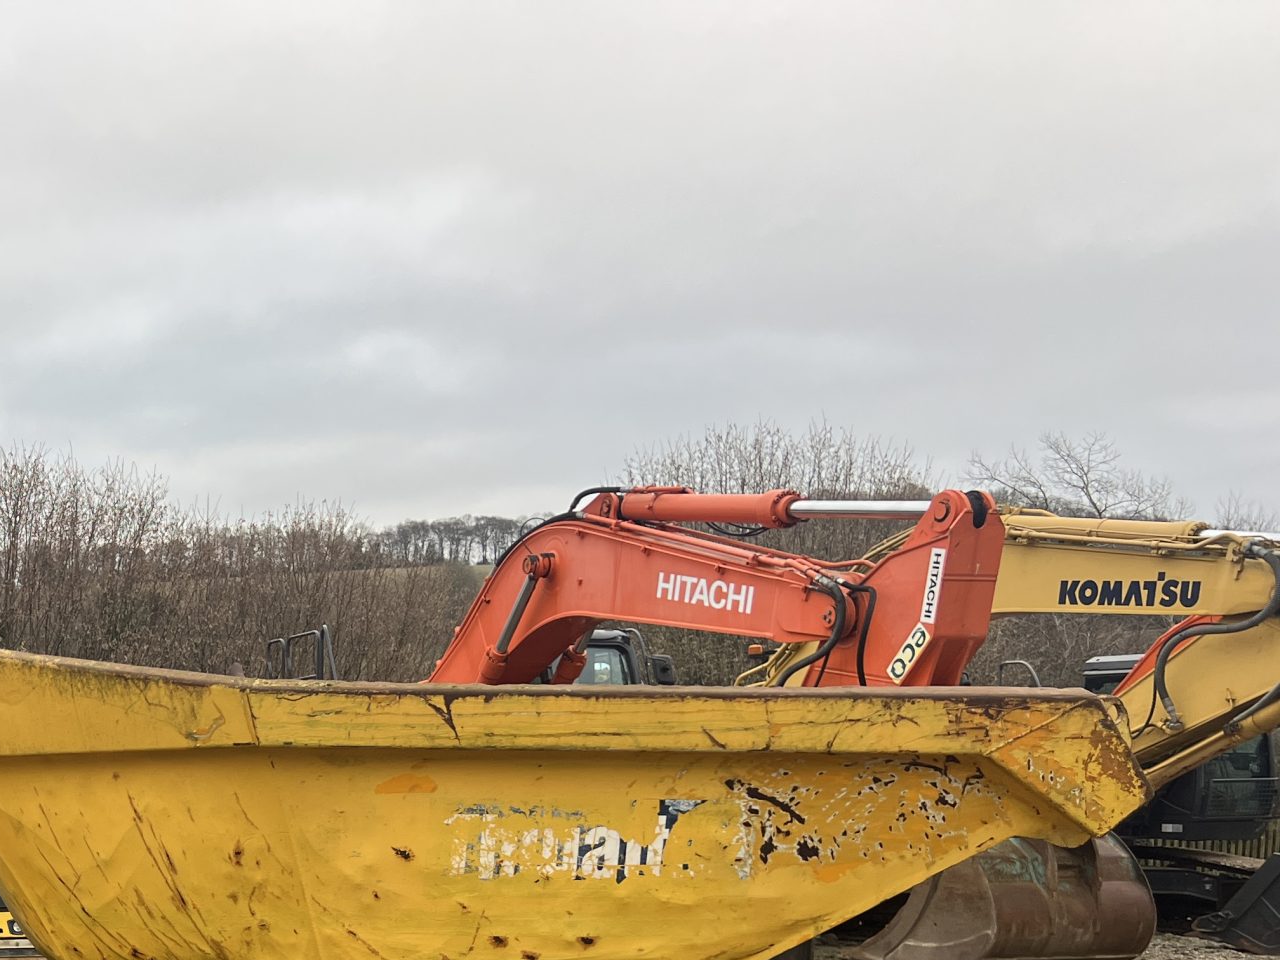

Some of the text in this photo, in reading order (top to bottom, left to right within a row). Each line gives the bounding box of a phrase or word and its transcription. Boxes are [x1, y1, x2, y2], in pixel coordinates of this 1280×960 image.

[656, 571, 754, 614] HITACHI
[924, 553, 942, 619] HITACHI
[1058, 571, 1201, 607] KOMATSU
[890, 627, 926, 679] eco
